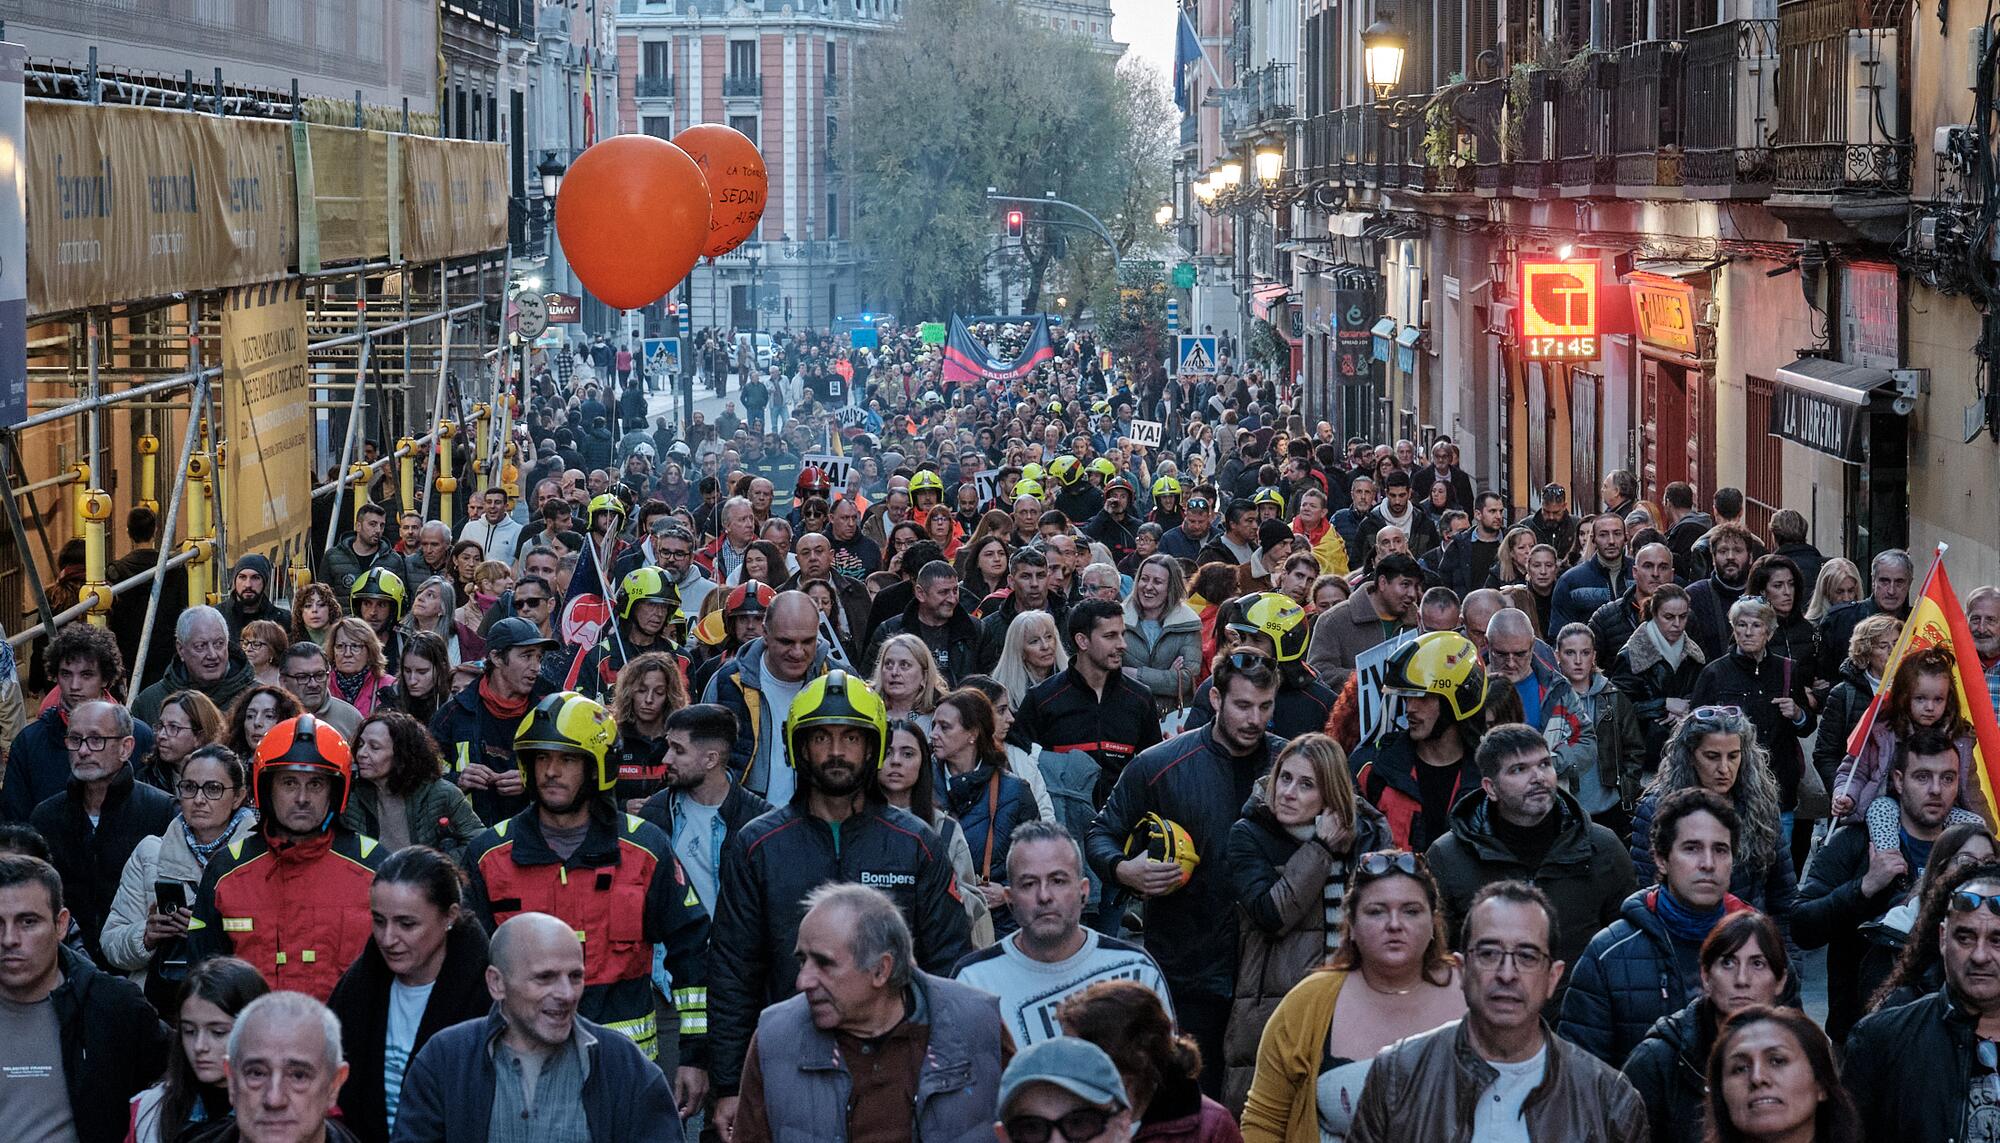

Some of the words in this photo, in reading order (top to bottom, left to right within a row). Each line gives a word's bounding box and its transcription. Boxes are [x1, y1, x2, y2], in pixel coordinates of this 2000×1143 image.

[1530, 337, 1595, 356] 17:45
[982, 369, 1019, 380] GALICIA
[1784, 392, 1797, 436] LA
[1801, 397, 1842, 451] LIBRERIA
[1131, 423, 1160, 442] ¡YA!
[1266, 622, 1281, 631] 995
[1433, 680, 1451, 689] 790
[861, 872, 915, 885] Bombers
